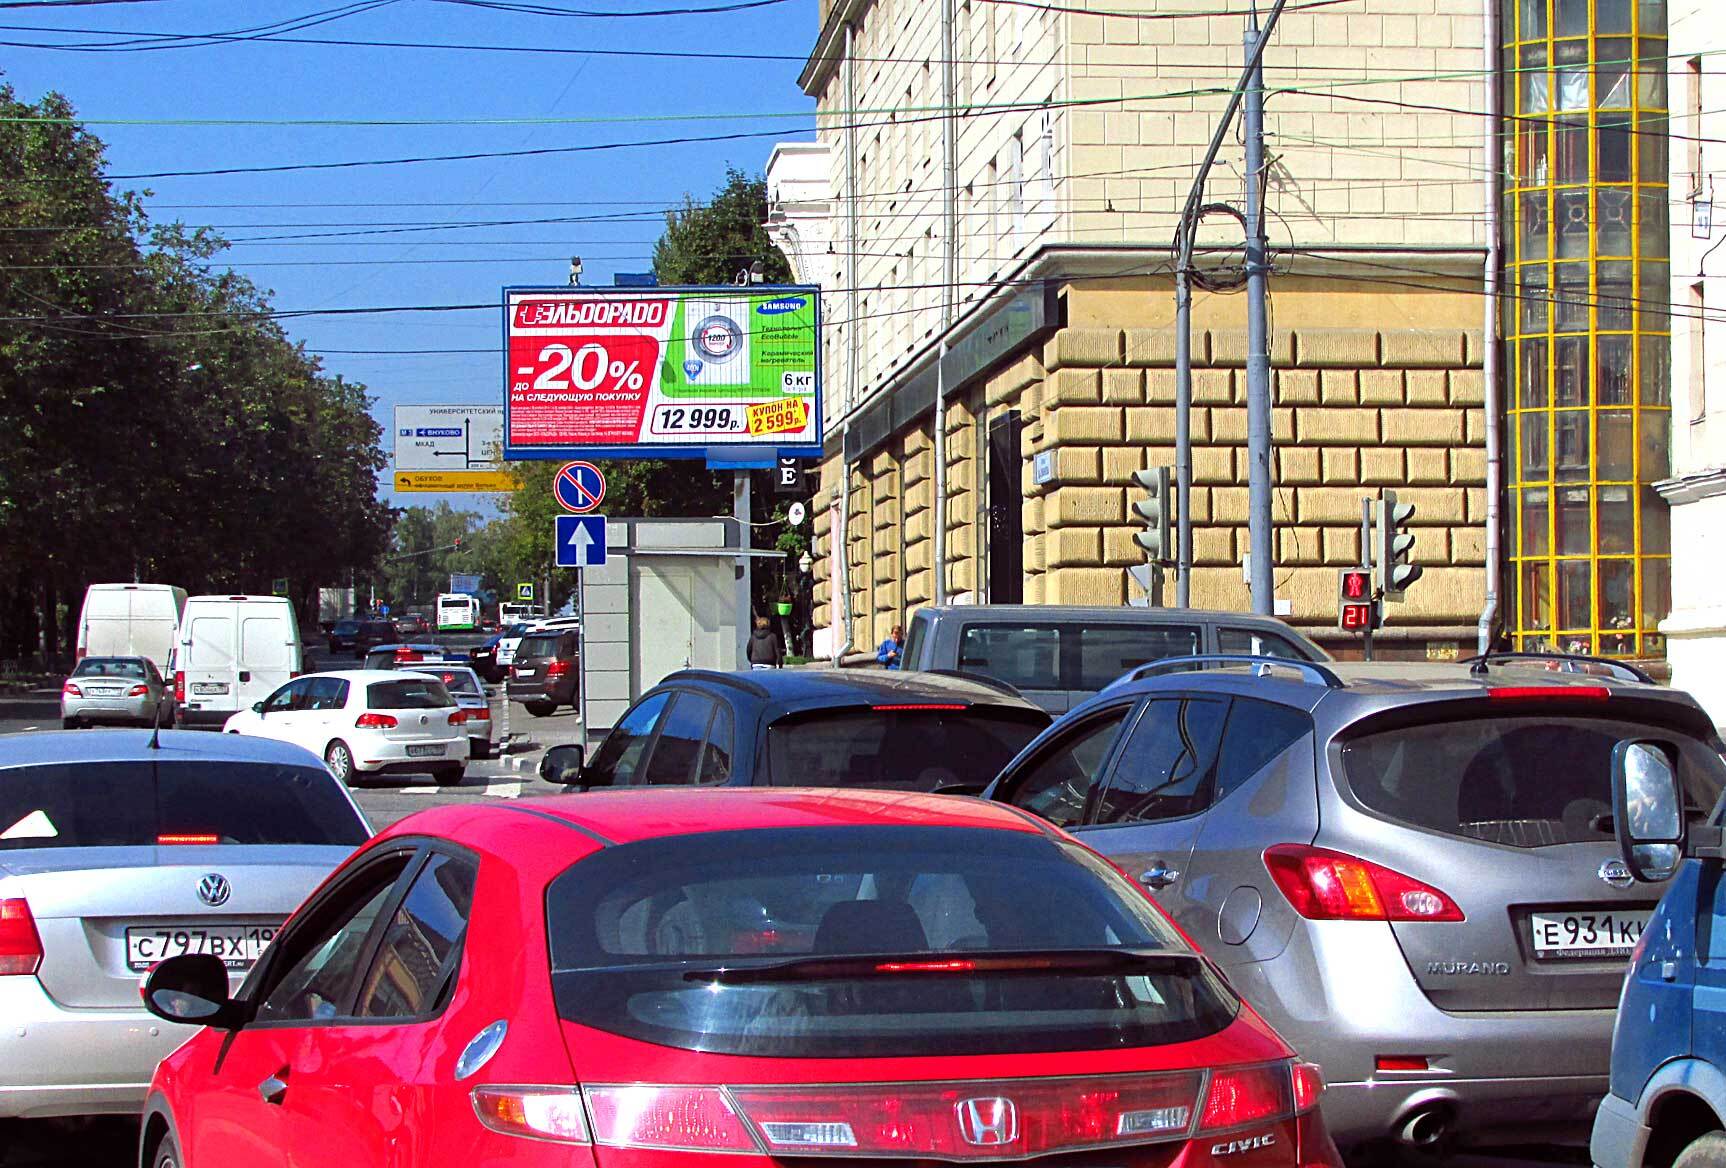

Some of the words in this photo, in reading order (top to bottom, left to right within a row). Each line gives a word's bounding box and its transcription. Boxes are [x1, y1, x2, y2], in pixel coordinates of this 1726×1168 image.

[708, 334, 726, 342] 1200
[517, 343, 644, 391] -20%
[785, 373, 793, 386] 6
[796, 376, 812, 386] кг
[511, 392, 526, 402] НА
[527, 392, 594, 403] СЛЕДУЮЩУЮ
[595, 391, 641, 402] ПОКУПКУ
[429, 407, 496, 416] УНИВЕРСИТЕТСКИЙ
[753, 402, 783, 417] КУПОН
[786, 399, 799, 410] НА
[661, 408, 685, 429] 12
[754, 418, 763, 433] 2
[1346, 607, 1367, 625] 21
[138, 931, 243, 957] С797ВХ
[249, 929, 279, 949] 19
[1427, 961, 1511, 976] MURANO
[1211, 1133, 1276, 1156] CIVIC
